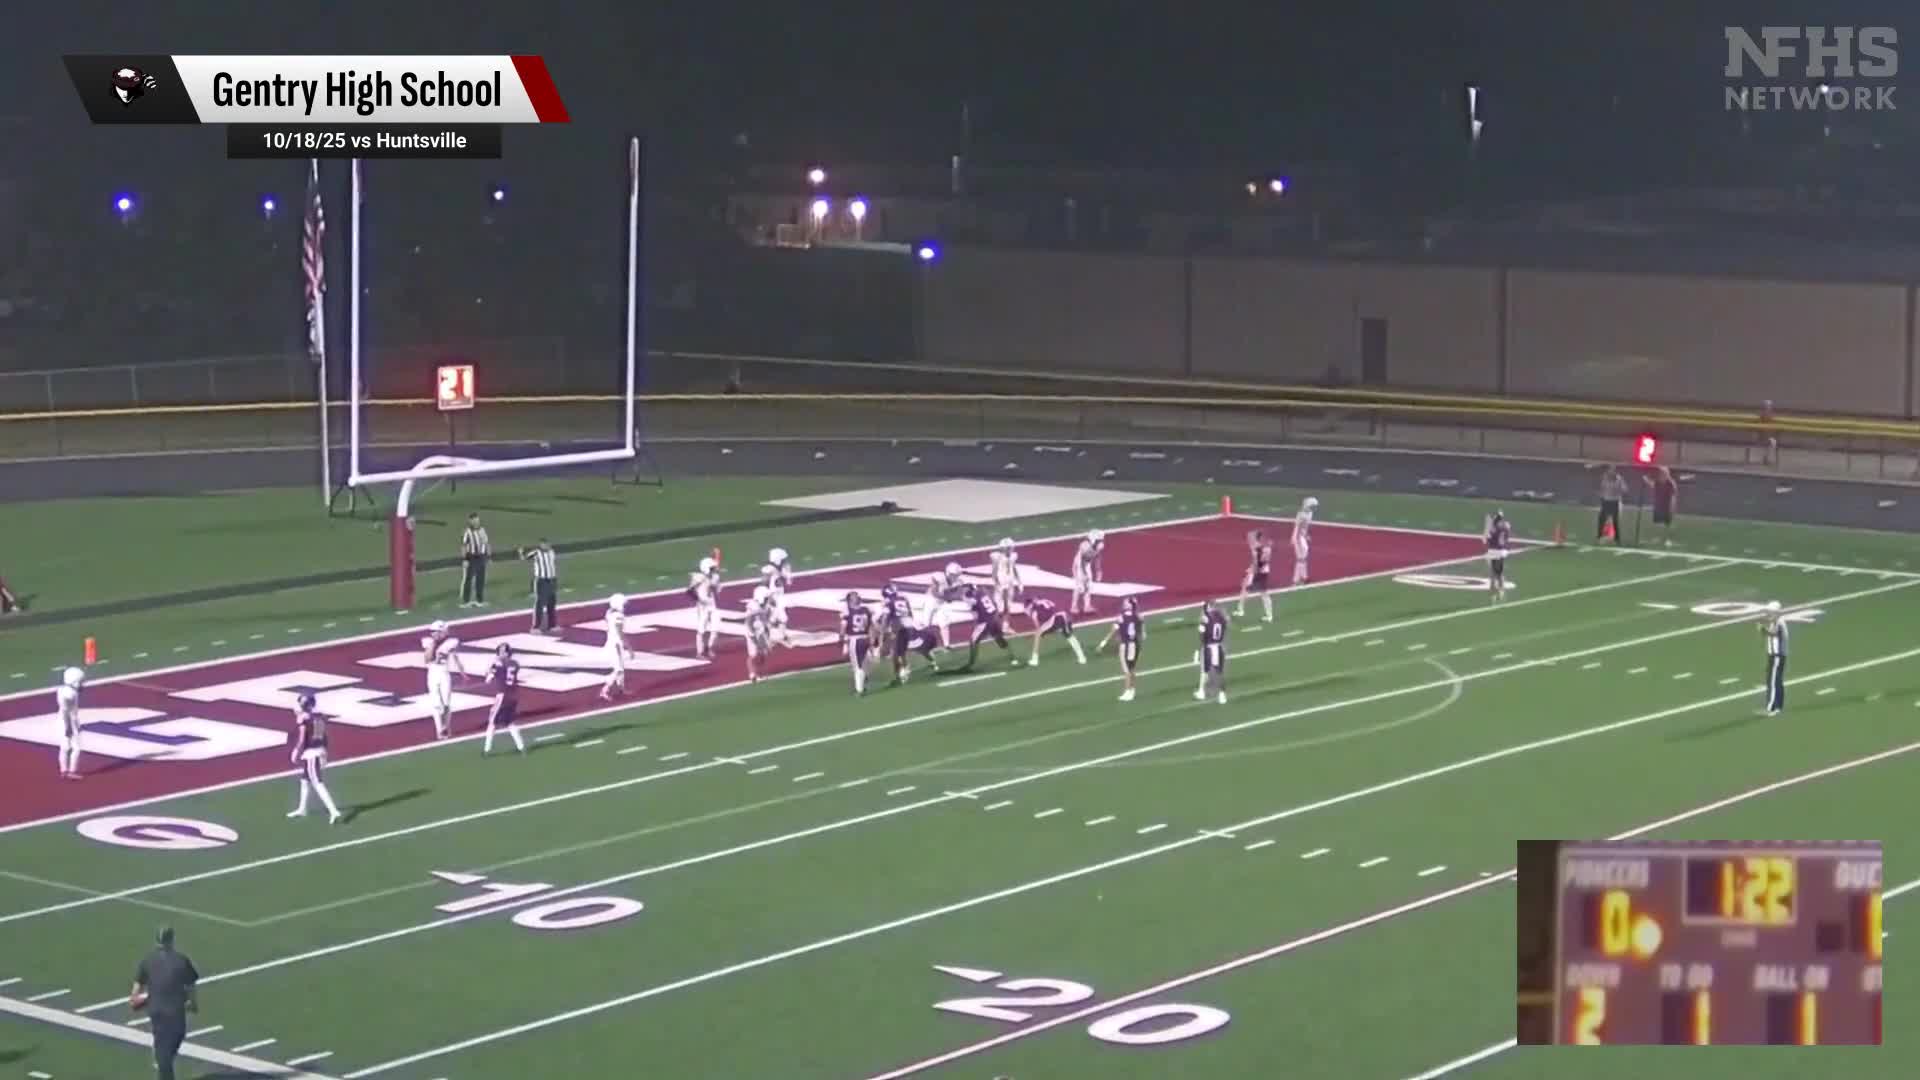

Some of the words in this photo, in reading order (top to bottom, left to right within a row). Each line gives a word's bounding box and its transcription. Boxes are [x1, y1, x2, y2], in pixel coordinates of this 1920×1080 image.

[440, 366, 472, 401] 21
[76, 816, 239, 850] G
[434, 882, 644, 929] 10
[1719, 857, 1794, 923] 1:22
[932, 978, 1231, 1044] 20
